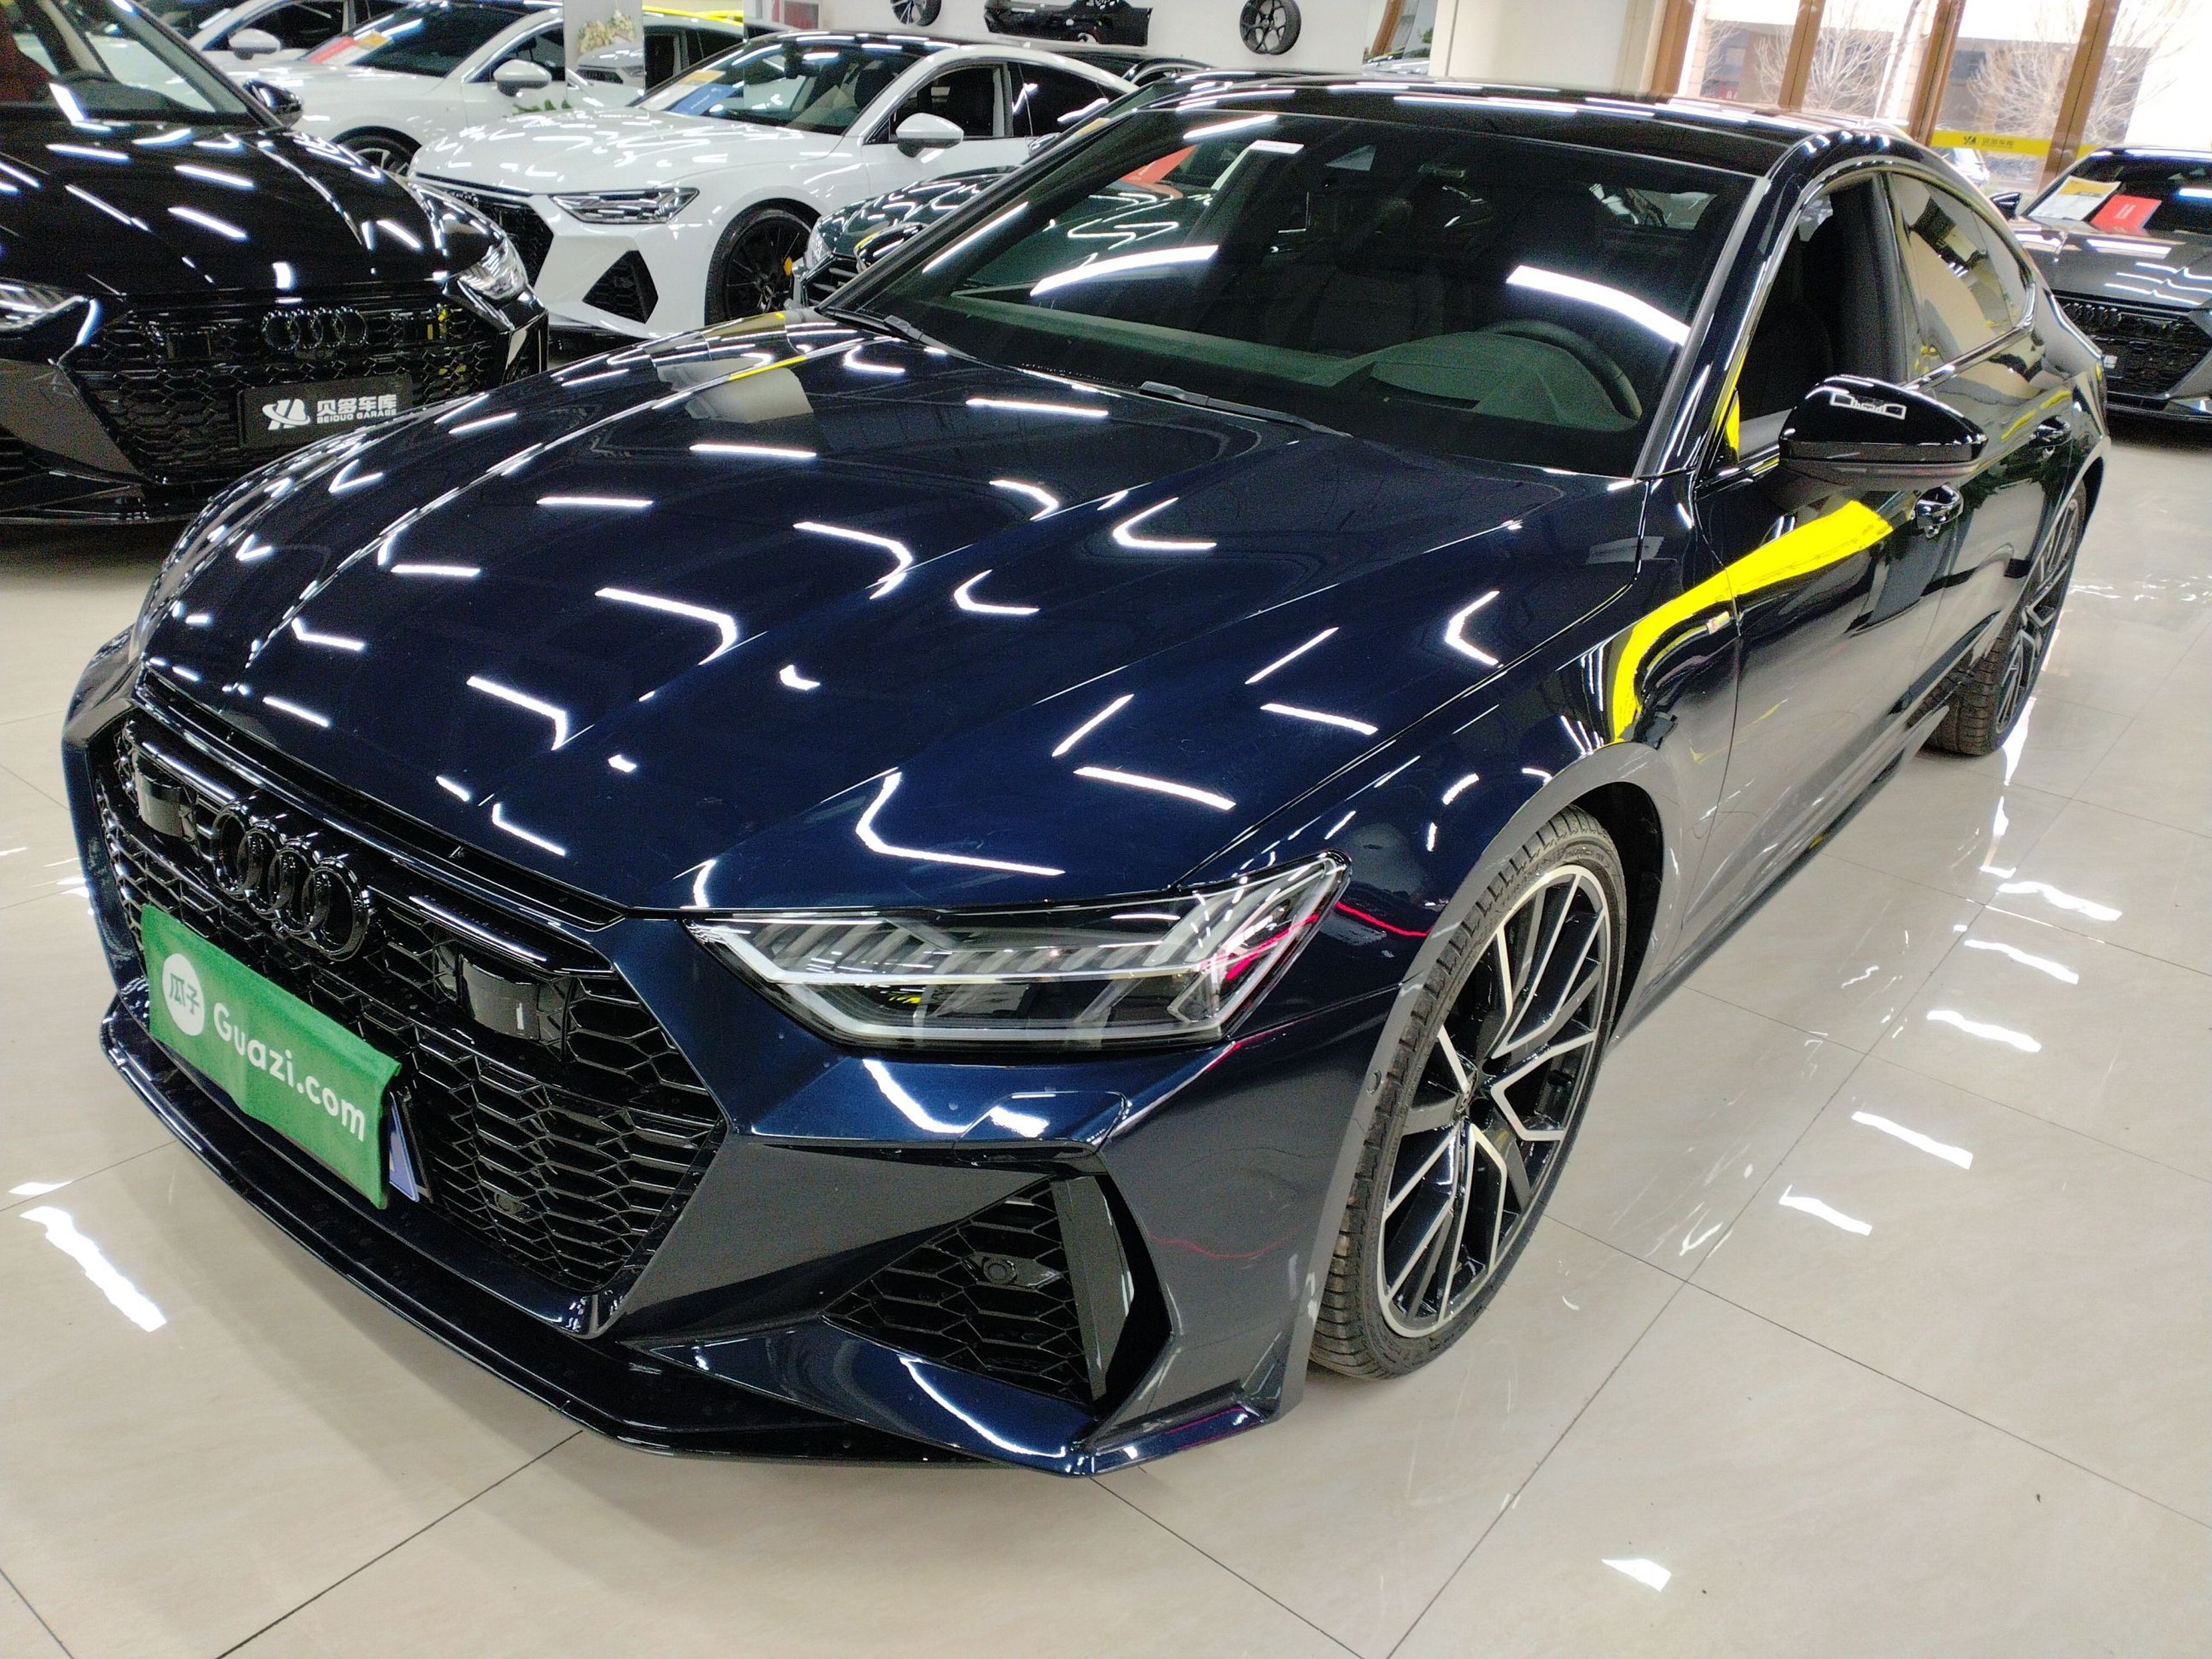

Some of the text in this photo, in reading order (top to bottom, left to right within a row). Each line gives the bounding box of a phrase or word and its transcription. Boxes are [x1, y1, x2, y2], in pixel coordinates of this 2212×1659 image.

[316, 394, 397, 416] 贝多车库
[316, 408, 397, 424] BEIDUO GARAGE
[169, 972, 200, 1016] 瓜子
[213, 1002, 366, 1142] Guazi.com
